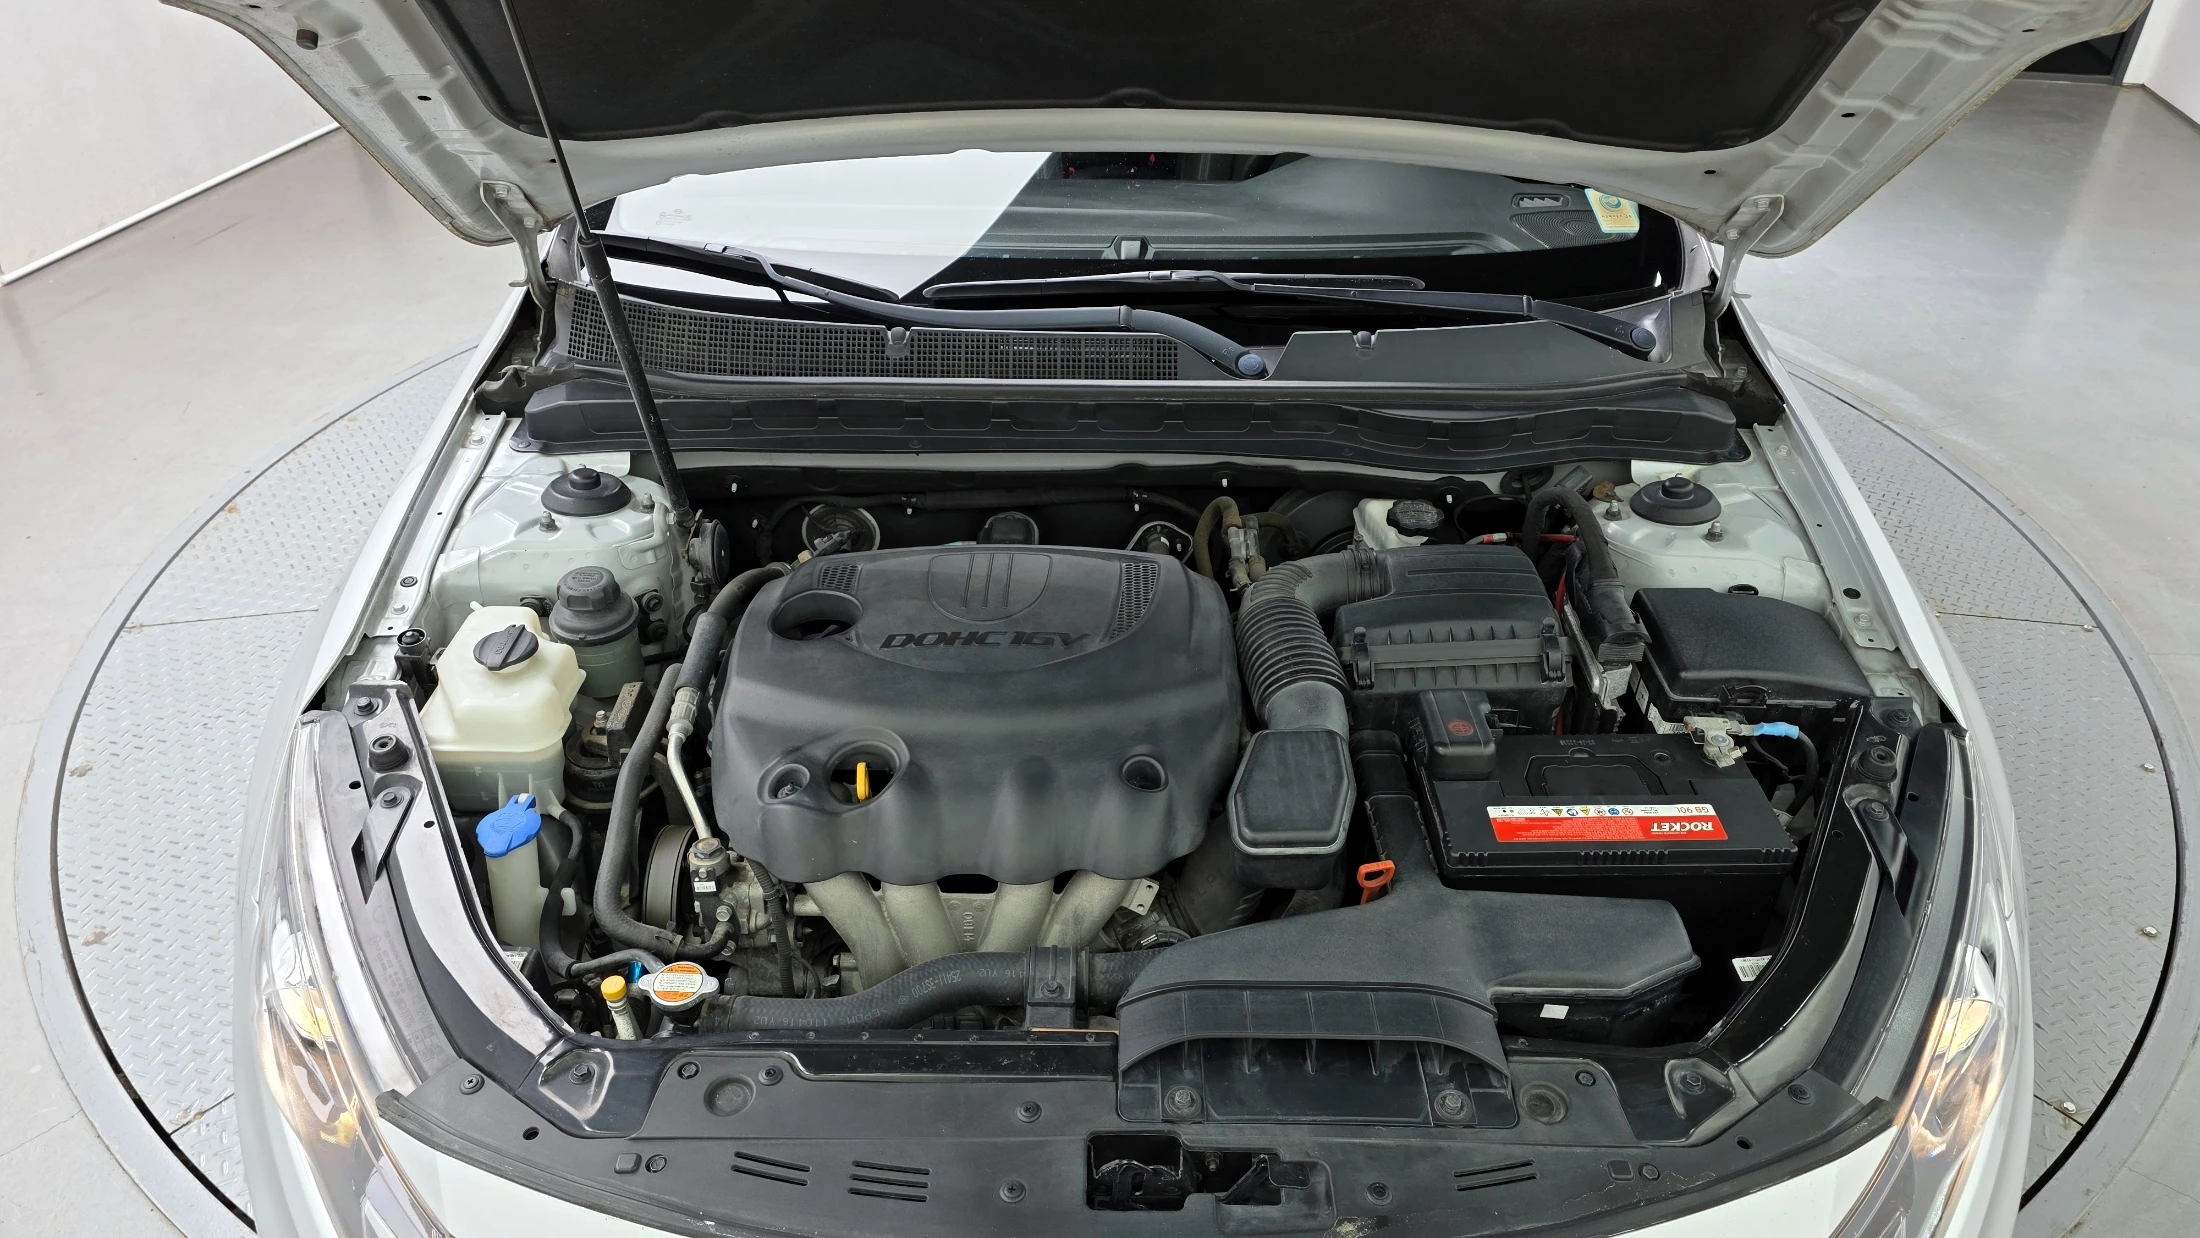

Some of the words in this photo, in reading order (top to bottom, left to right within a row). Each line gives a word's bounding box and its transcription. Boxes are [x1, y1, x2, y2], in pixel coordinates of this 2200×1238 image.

[879, 631, 1007, 650] DOHC
[1008, 631, 1092, 650] 16V
[1673, 806, 1693, 814] 90L
[1694, 806, 1710, 814] GB
[1650, 821, 1714, 832] ROCKET
